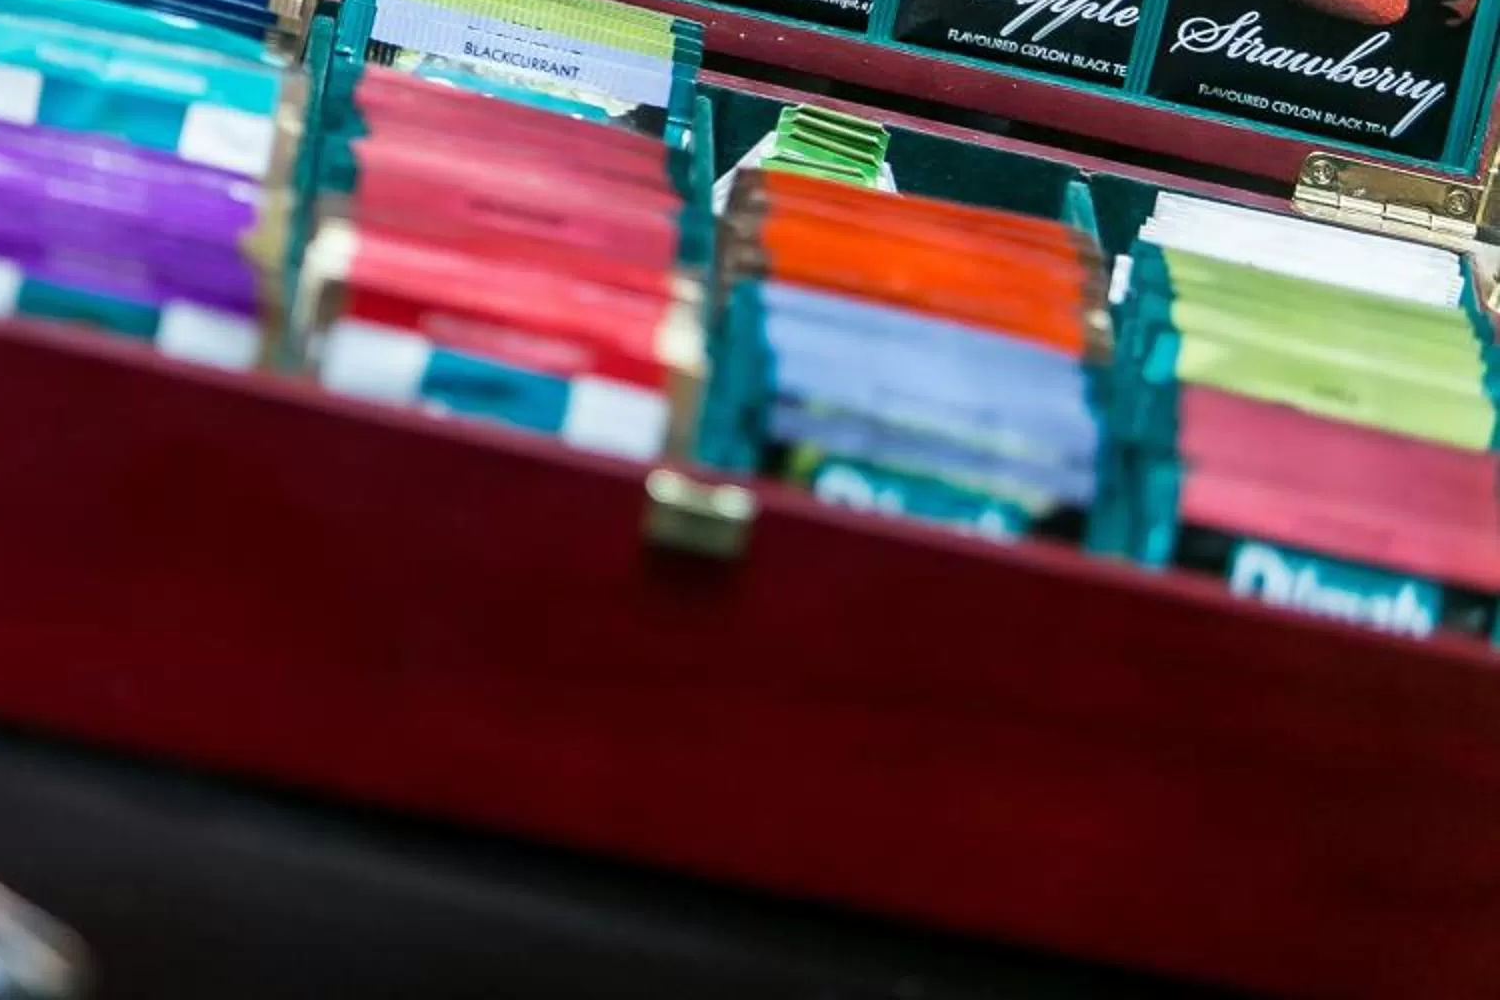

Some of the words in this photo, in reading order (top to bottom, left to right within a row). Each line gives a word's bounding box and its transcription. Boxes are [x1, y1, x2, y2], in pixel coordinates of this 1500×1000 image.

[463, 41, 580, 78] BLACKCURRANT
[947, 28, 1018, 53] FLAVOURED
[1020, 43, 1071, 64] CEYLON
[1072, 55, 1110, 73] BLACK
[1112, 63, 1128, 77] TE
[1169, 10, 1447, 137] Strawberry
[1198, 83, 1269, 110] FLAVOURED
[1271, 100, 1323, 122] CEYLON
[1324, 112, 1362, 131] BLACK
[1365, 122, 1389, 138] TEA
